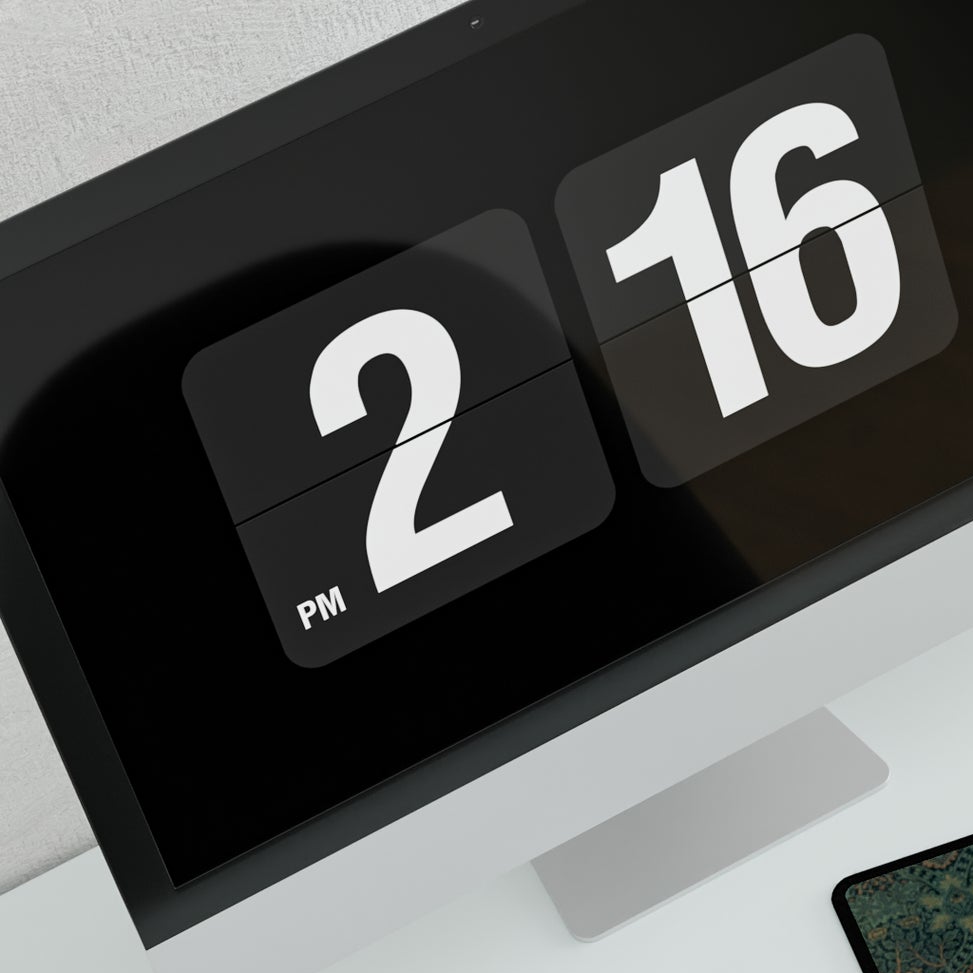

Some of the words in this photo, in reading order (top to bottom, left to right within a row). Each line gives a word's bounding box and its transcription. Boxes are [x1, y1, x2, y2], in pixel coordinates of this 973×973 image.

[309, 308, 514, 594] 2
[605, 102, 901, 419] 16
[296, 585, 347, 630] PM
